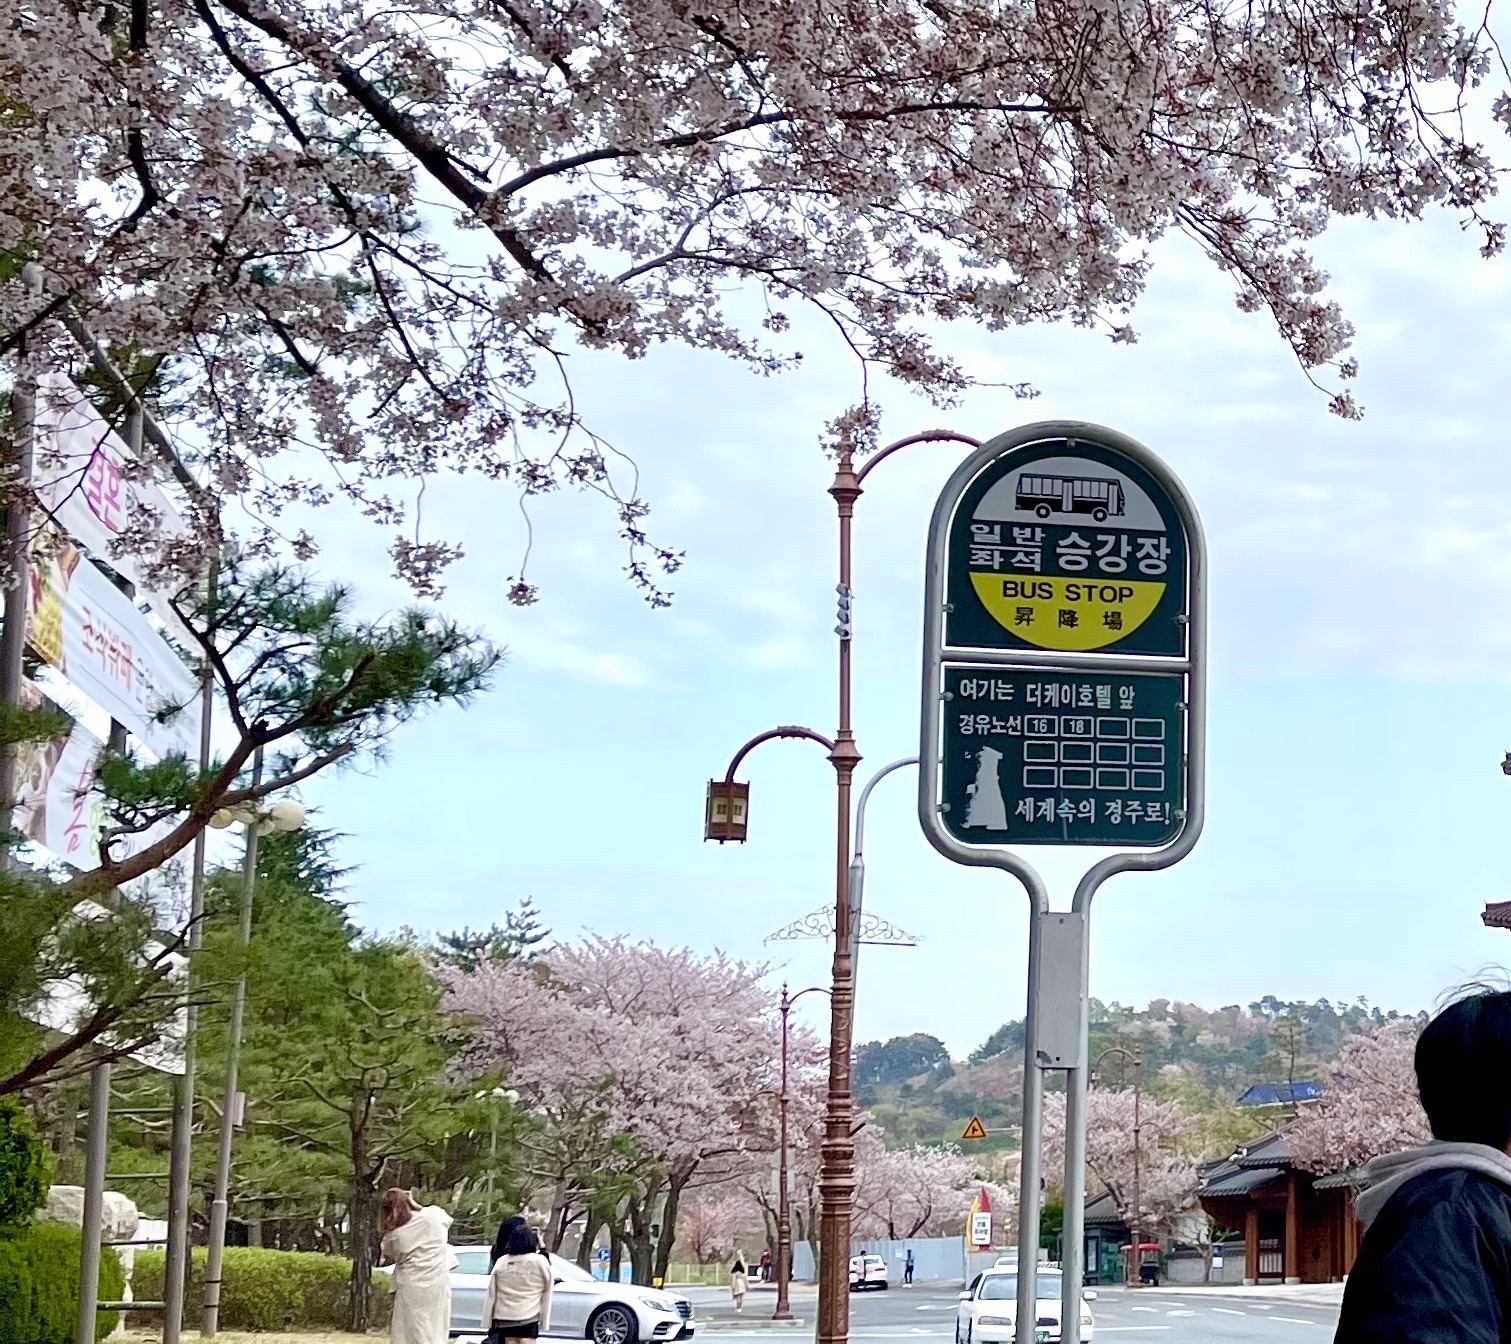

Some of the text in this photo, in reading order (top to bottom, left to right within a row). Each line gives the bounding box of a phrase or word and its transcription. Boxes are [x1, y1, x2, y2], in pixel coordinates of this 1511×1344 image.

[969, 523, 1046, 546] 일반
[968, 549, 1044, 572] 좌석
[1055, 531, 1172, 575] 승강장
[1002, 580, 1135, 604] BUS STOP
[1014, 606, 1123, 631] 昇降場
[959, 679, 1136, 709] 여기는 더케이호텔 앞
[958, 714, 1085, 736] 경유노선 16 18
[1014, 797, 1171, 825] 세계속의 경주로!
